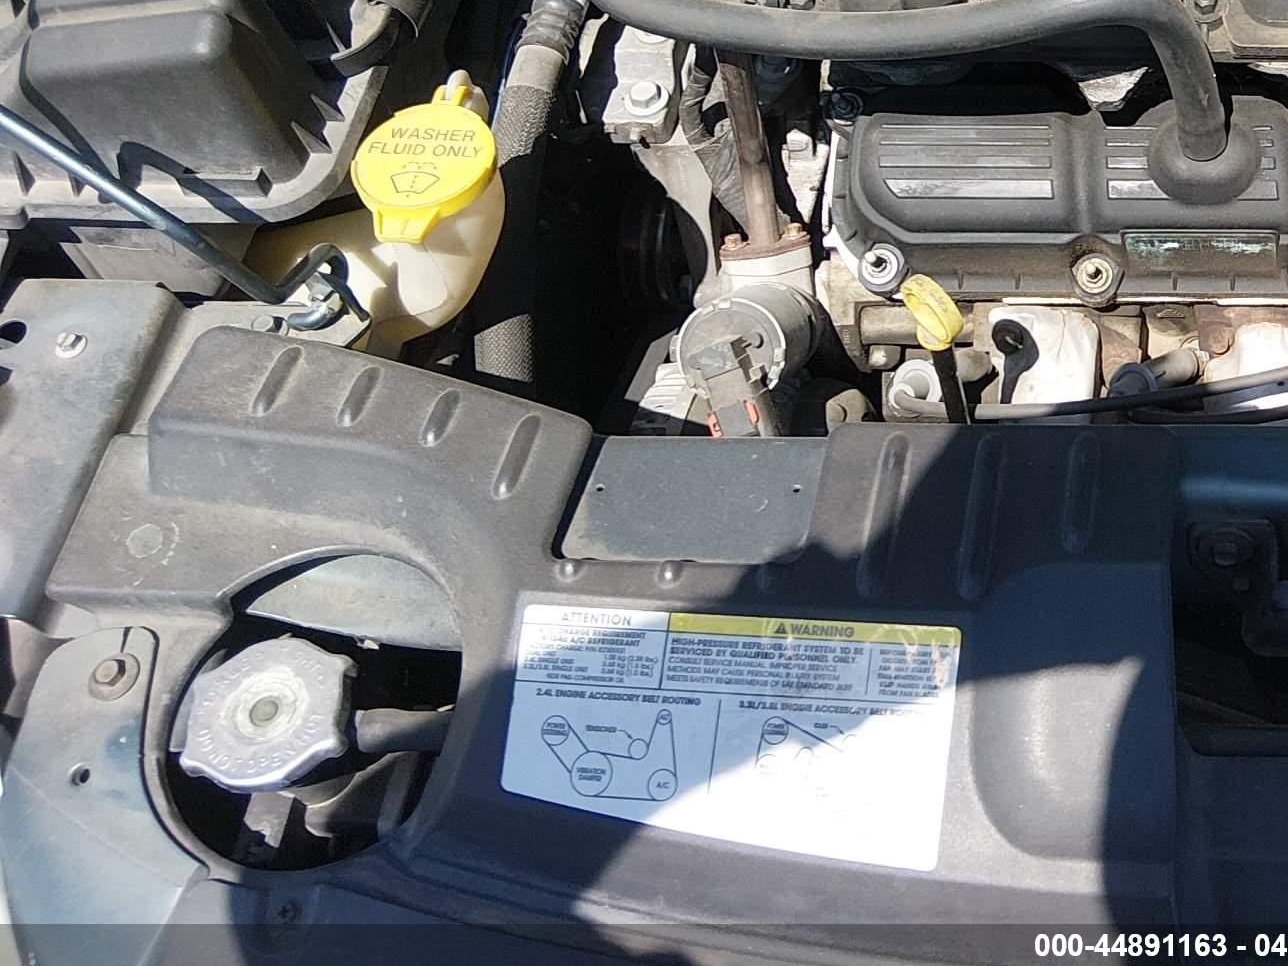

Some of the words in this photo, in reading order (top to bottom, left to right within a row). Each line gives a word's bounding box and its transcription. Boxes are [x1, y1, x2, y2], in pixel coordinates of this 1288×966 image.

[391, 128, 476, 142] WASHER
[368, 142, 426, 155] FLUID
[433, 144, 483, 158] ONLY
[561, 612, 632, 626] ATTENTION
[790, 623, 855, 637] WARNING
[778, 653, 829, 663] PSONNEL
[554, 689, 587, 700] ENGINE
[662, 695, 702, 706] ROUTING
